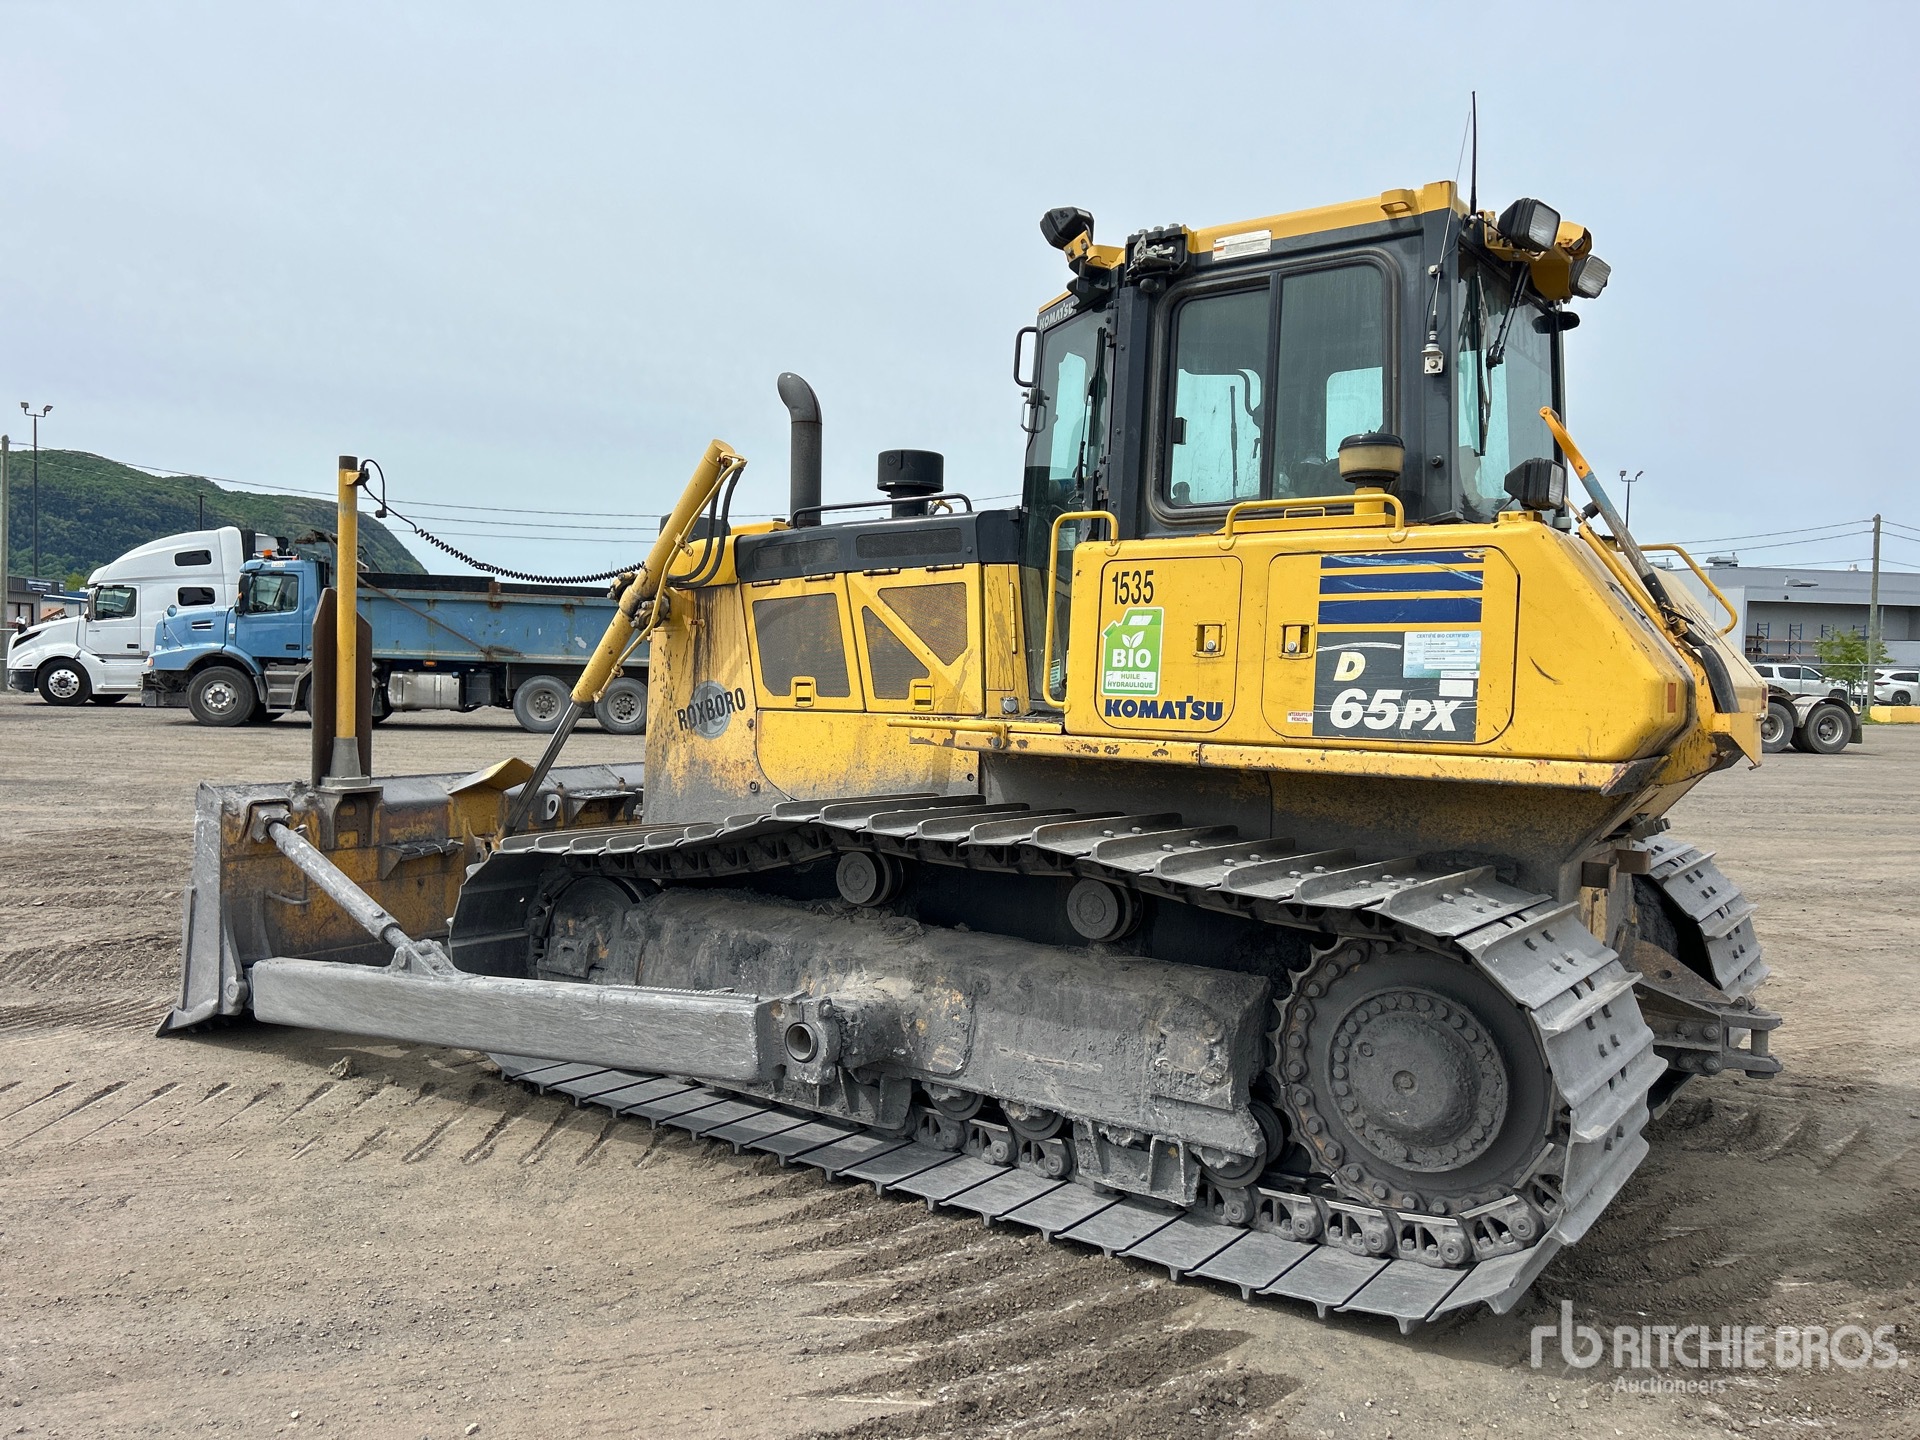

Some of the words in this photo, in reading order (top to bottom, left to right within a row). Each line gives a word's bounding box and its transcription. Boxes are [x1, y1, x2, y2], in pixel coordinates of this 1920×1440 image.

[1112, 569, 1154, 605] 1535
[1112, 648, 1152, 669] BIO
[1333, 651, 1367, 682] D
[1107, 680, 1154, 689] HYDRAULIQUE
[677, 688, 746, 731] ROXBORO
[1104, 696, 1224, 722] KOMATSU
